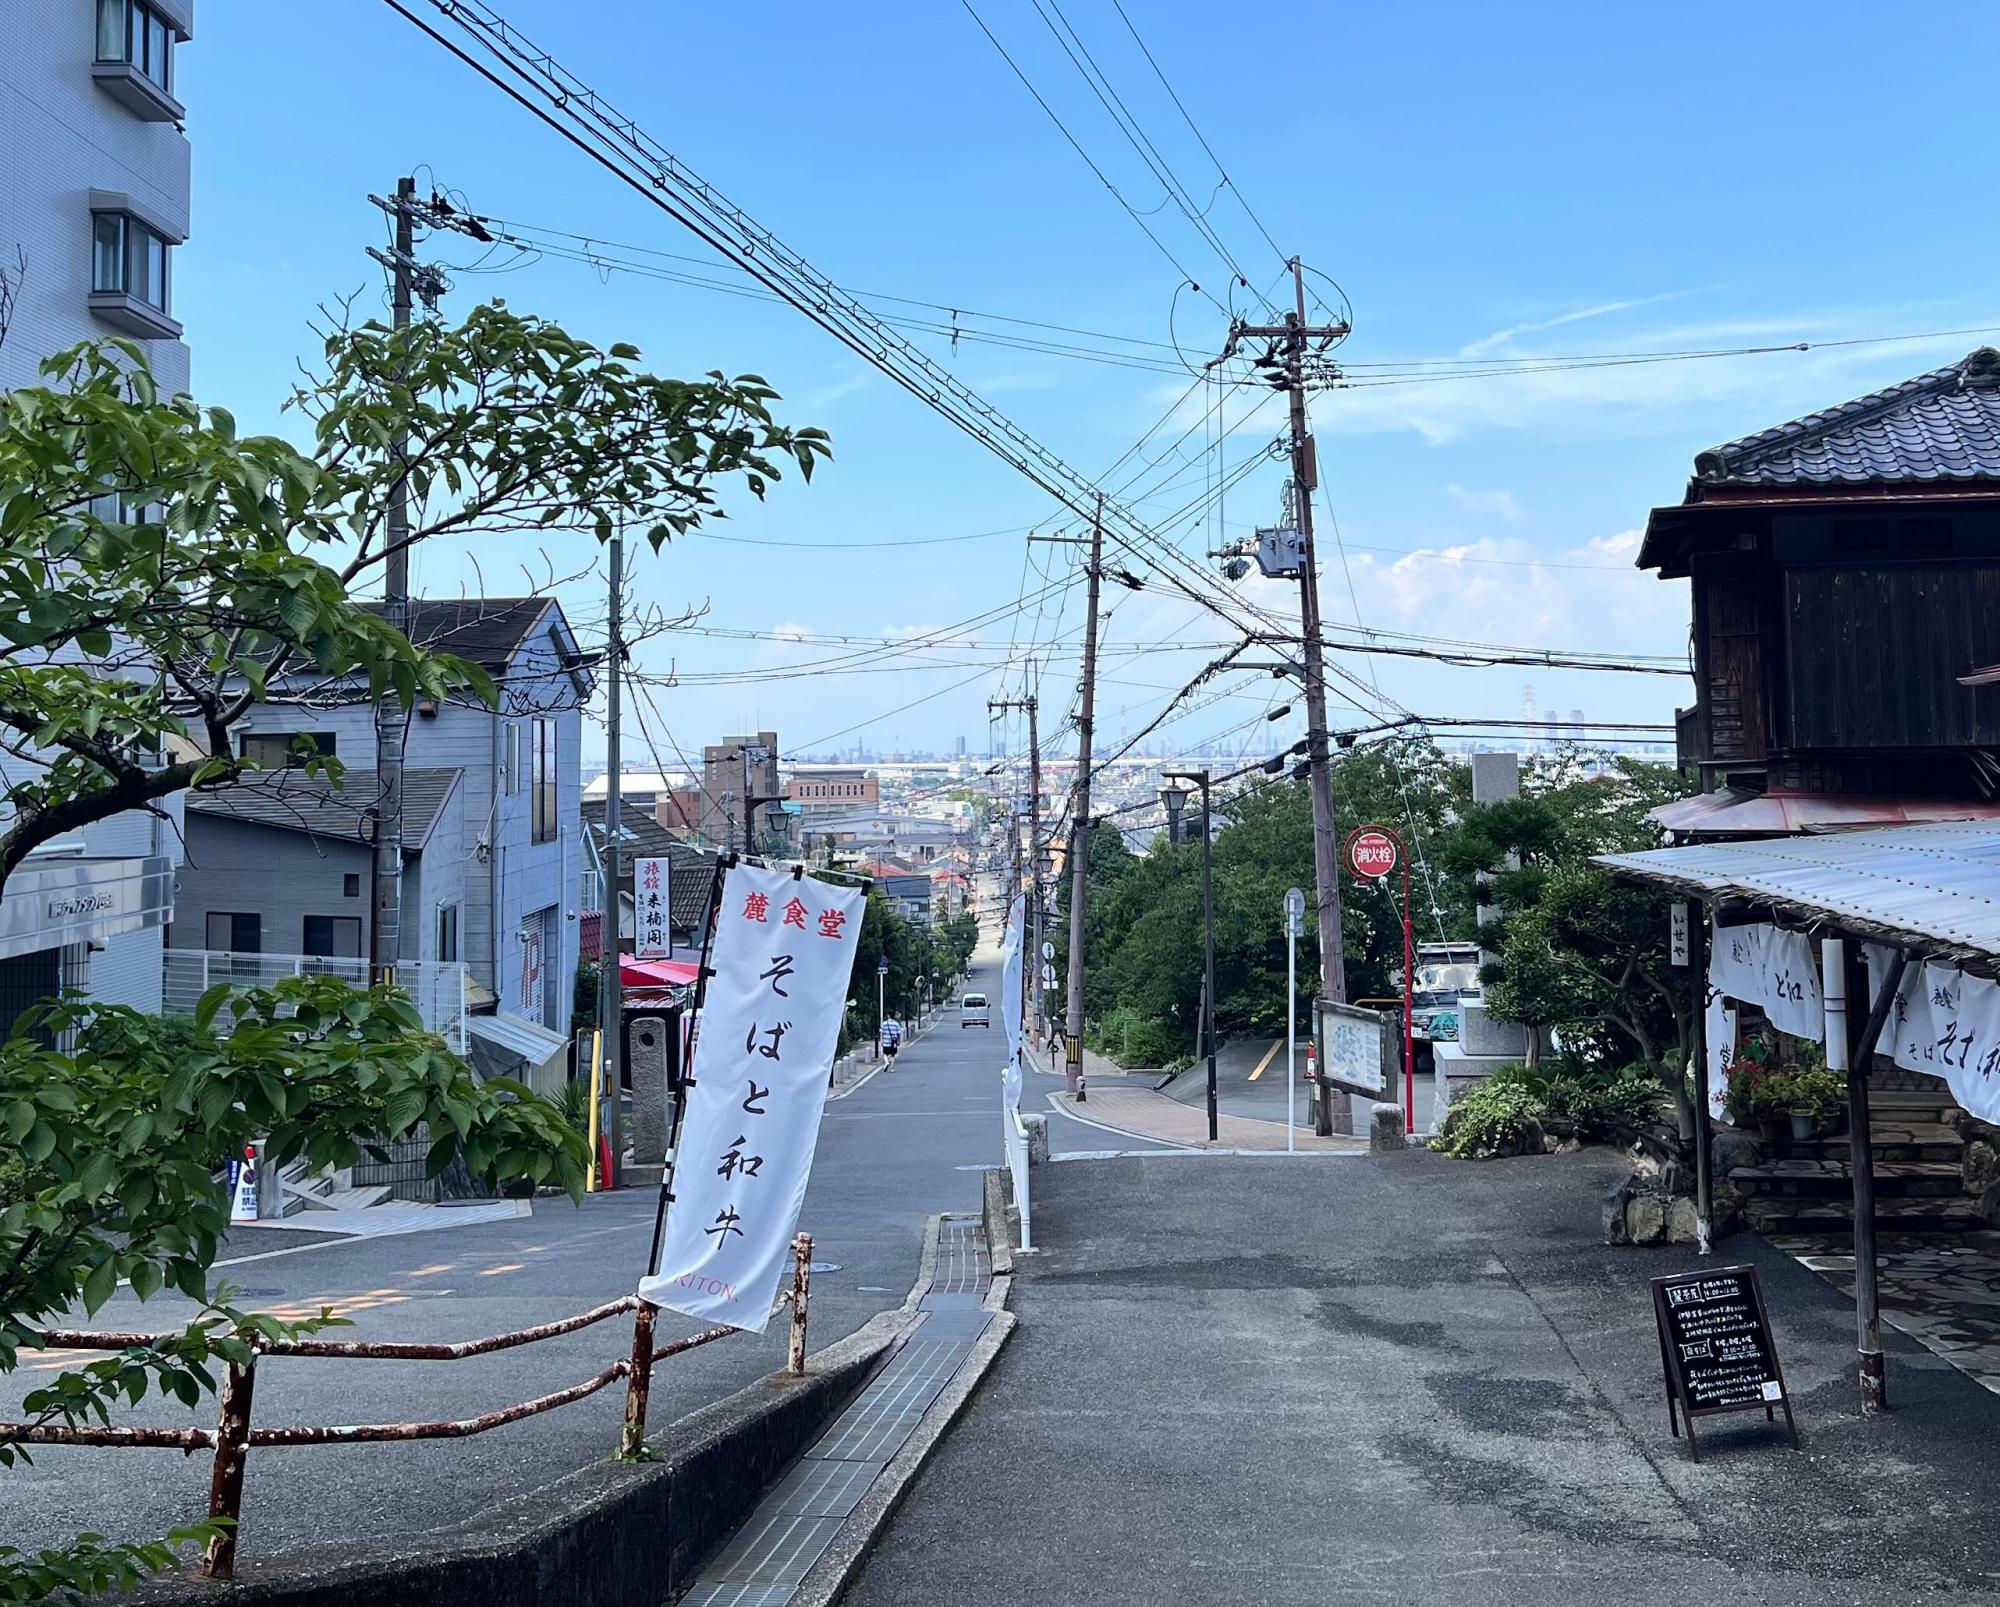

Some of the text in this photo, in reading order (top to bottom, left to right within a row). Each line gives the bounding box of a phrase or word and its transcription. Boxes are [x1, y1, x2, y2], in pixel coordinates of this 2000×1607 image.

[643, 861, 661, 890] 旅館
[1357, 846, 1392, 863] 消火栓
[740, 891, 848, 941] 麓食堂
[1673, 914, 1685, 958] いせや
[703, 954, 793, 1251] そばと和牛
